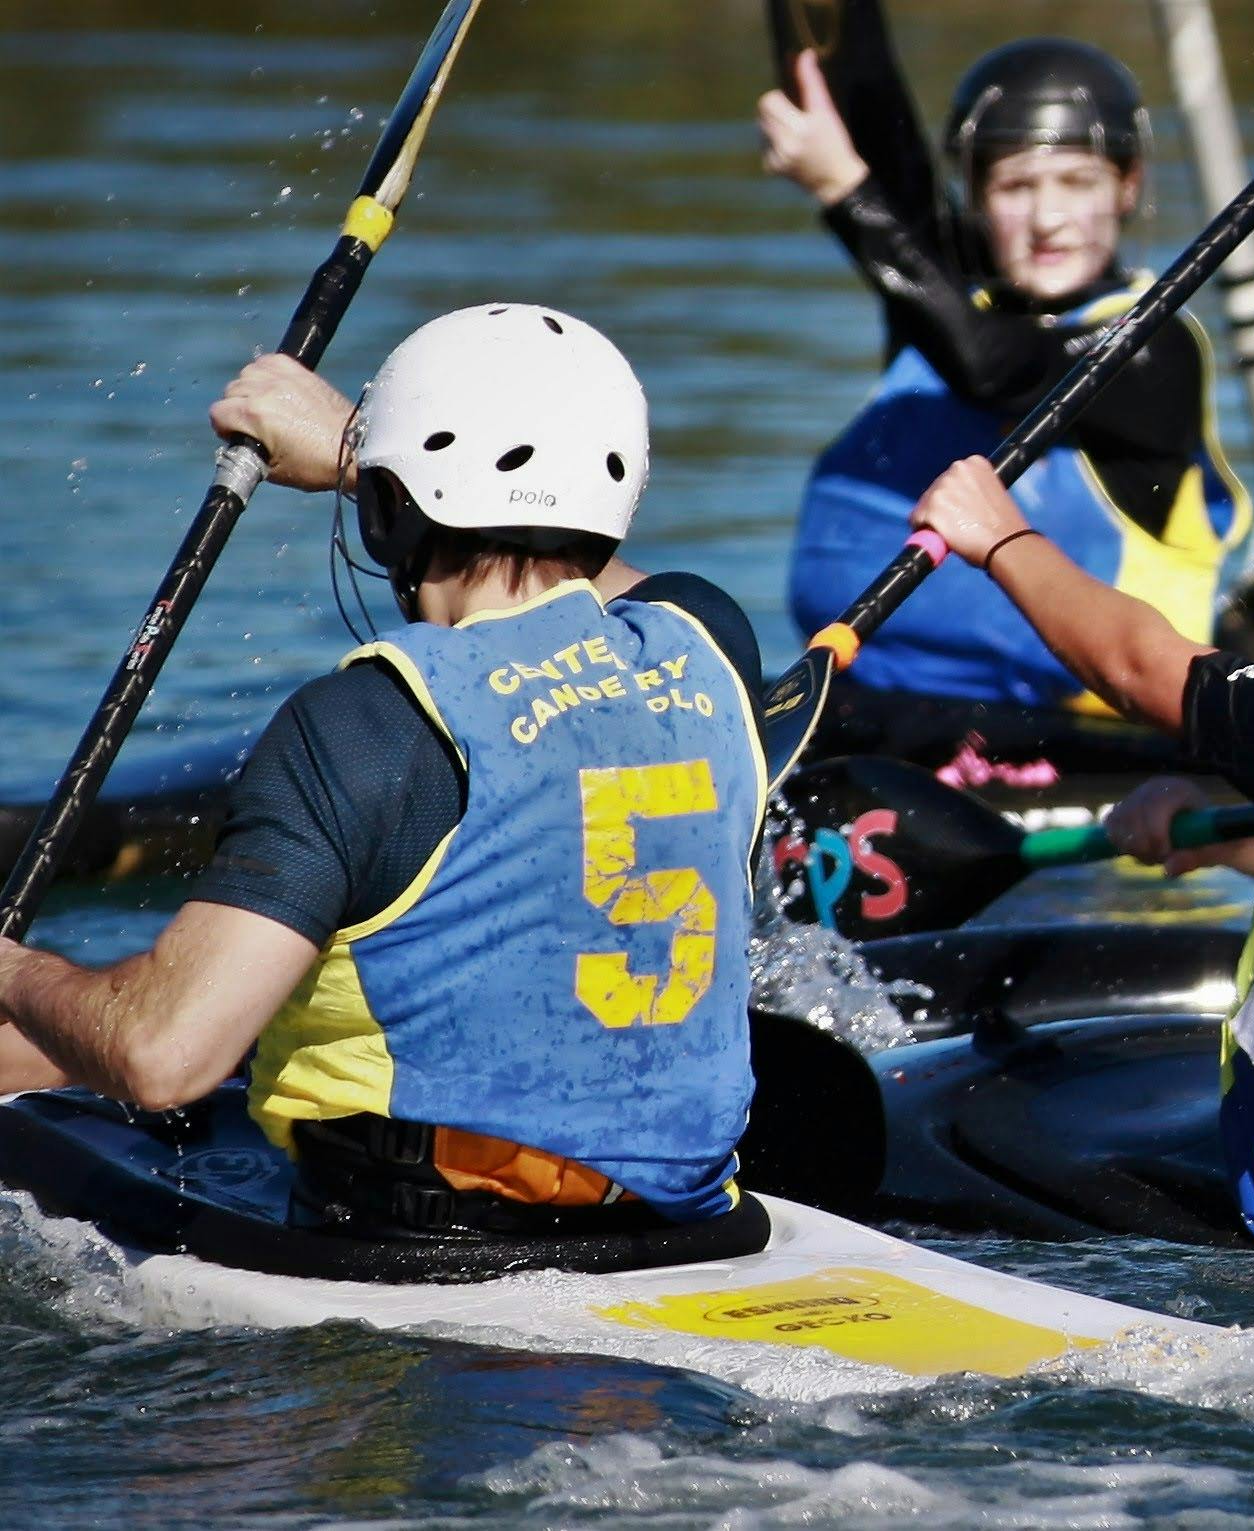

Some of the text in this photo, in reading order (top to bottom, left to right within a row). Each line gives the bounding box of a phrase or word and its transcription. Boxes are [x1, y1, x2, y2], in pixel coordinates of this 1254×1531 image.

[508, 489, 556, 507] polo
[511, 675, 627, 744] CANOE
[574, 757, 719, 1029] 5
